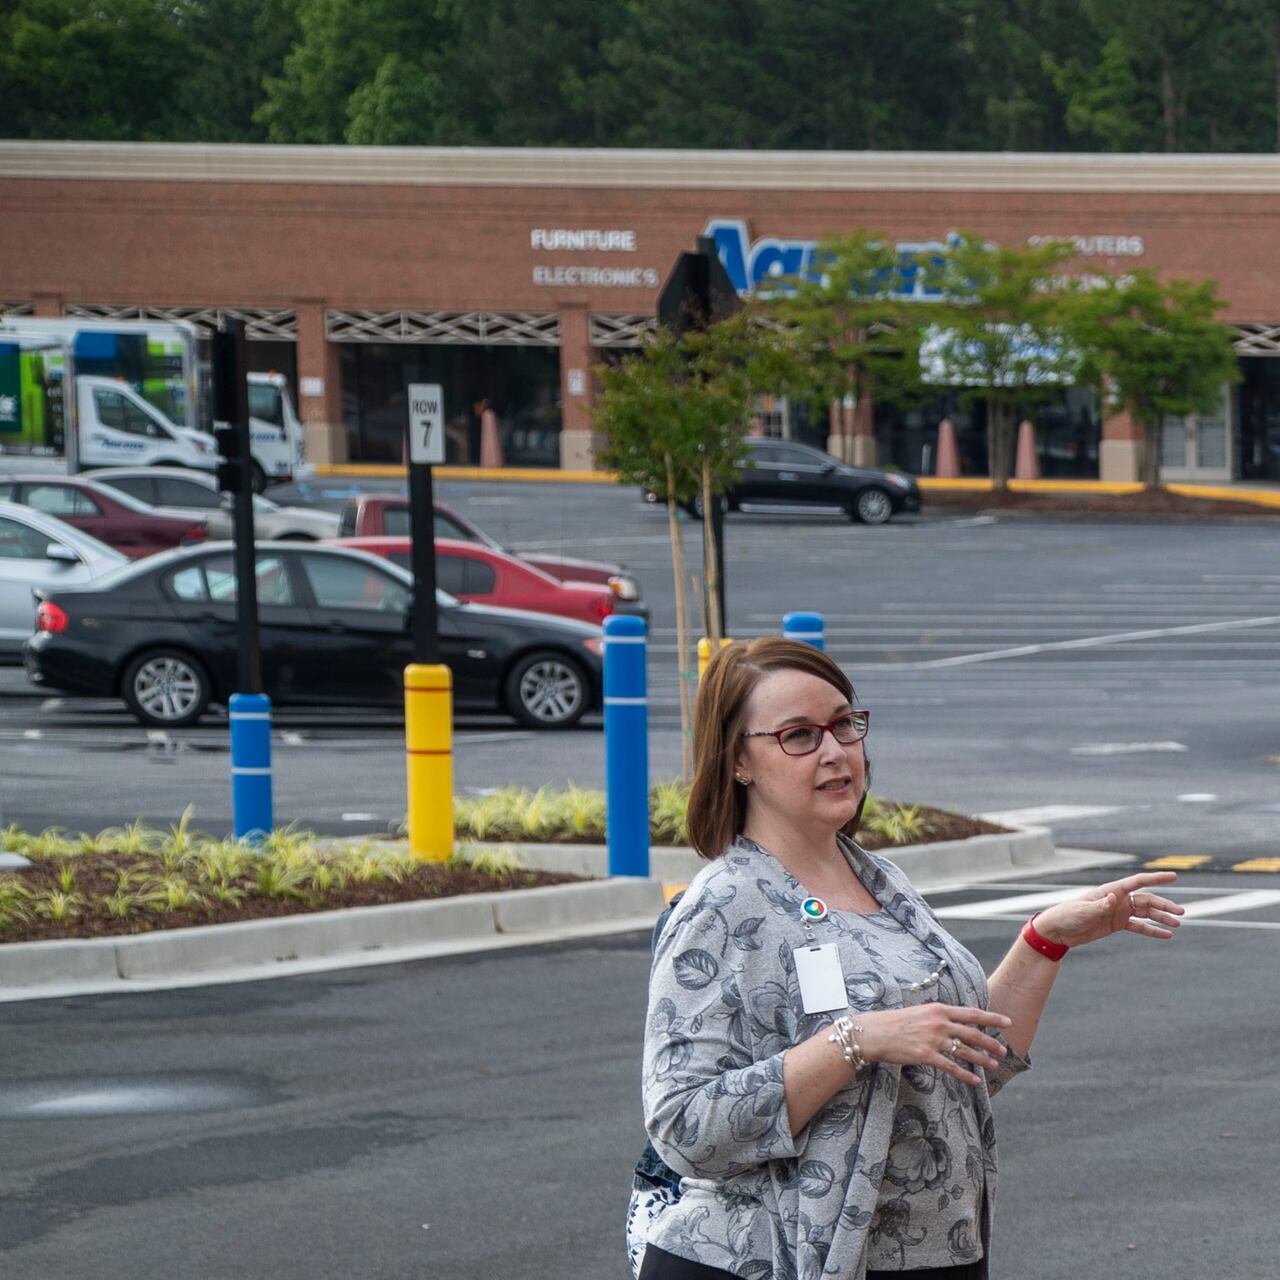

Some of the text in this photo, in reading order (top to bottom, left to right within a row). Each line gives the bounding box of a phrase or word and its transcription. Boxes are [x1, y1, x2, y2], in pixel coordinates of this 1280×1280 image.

[530, 228, 637, 252] FURNITURE
[1027, 234, 1145, 257] CPUTERS
[532, 265, 659, 288] ELECTRONICS
[412, 400, 438, 415] ROW
[420, 420, 432, 449] 7
